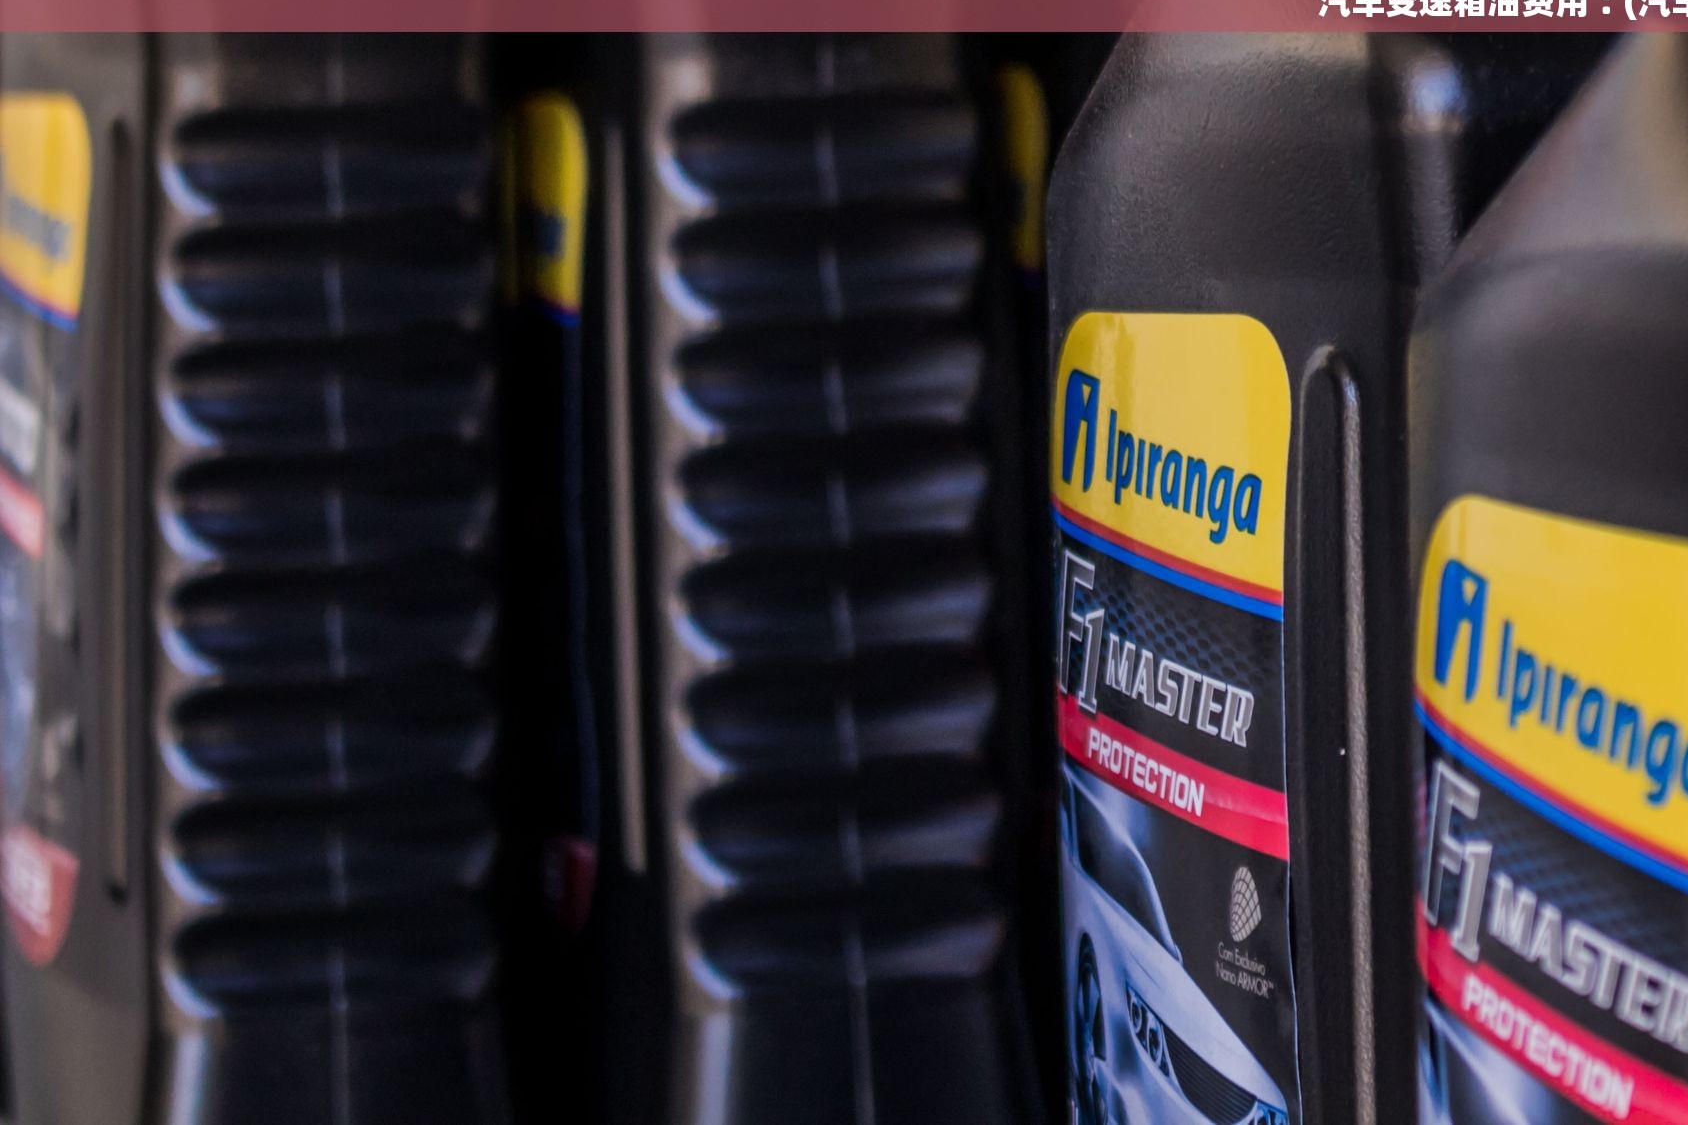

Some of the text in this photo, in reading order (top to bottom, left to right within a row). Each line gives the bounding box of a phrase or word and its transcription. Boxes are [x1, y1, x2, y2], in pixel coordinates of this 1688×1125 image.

[1105, 408, 1263, 545] Ipiranga
[1058, 549, 1255, 748] F1 MASTER
[1087, 727, 1205, 817] PROTECTION
[1423, 760, 1493, 964] F1
[1462, 971, 1635, 1120] PROTECTION
